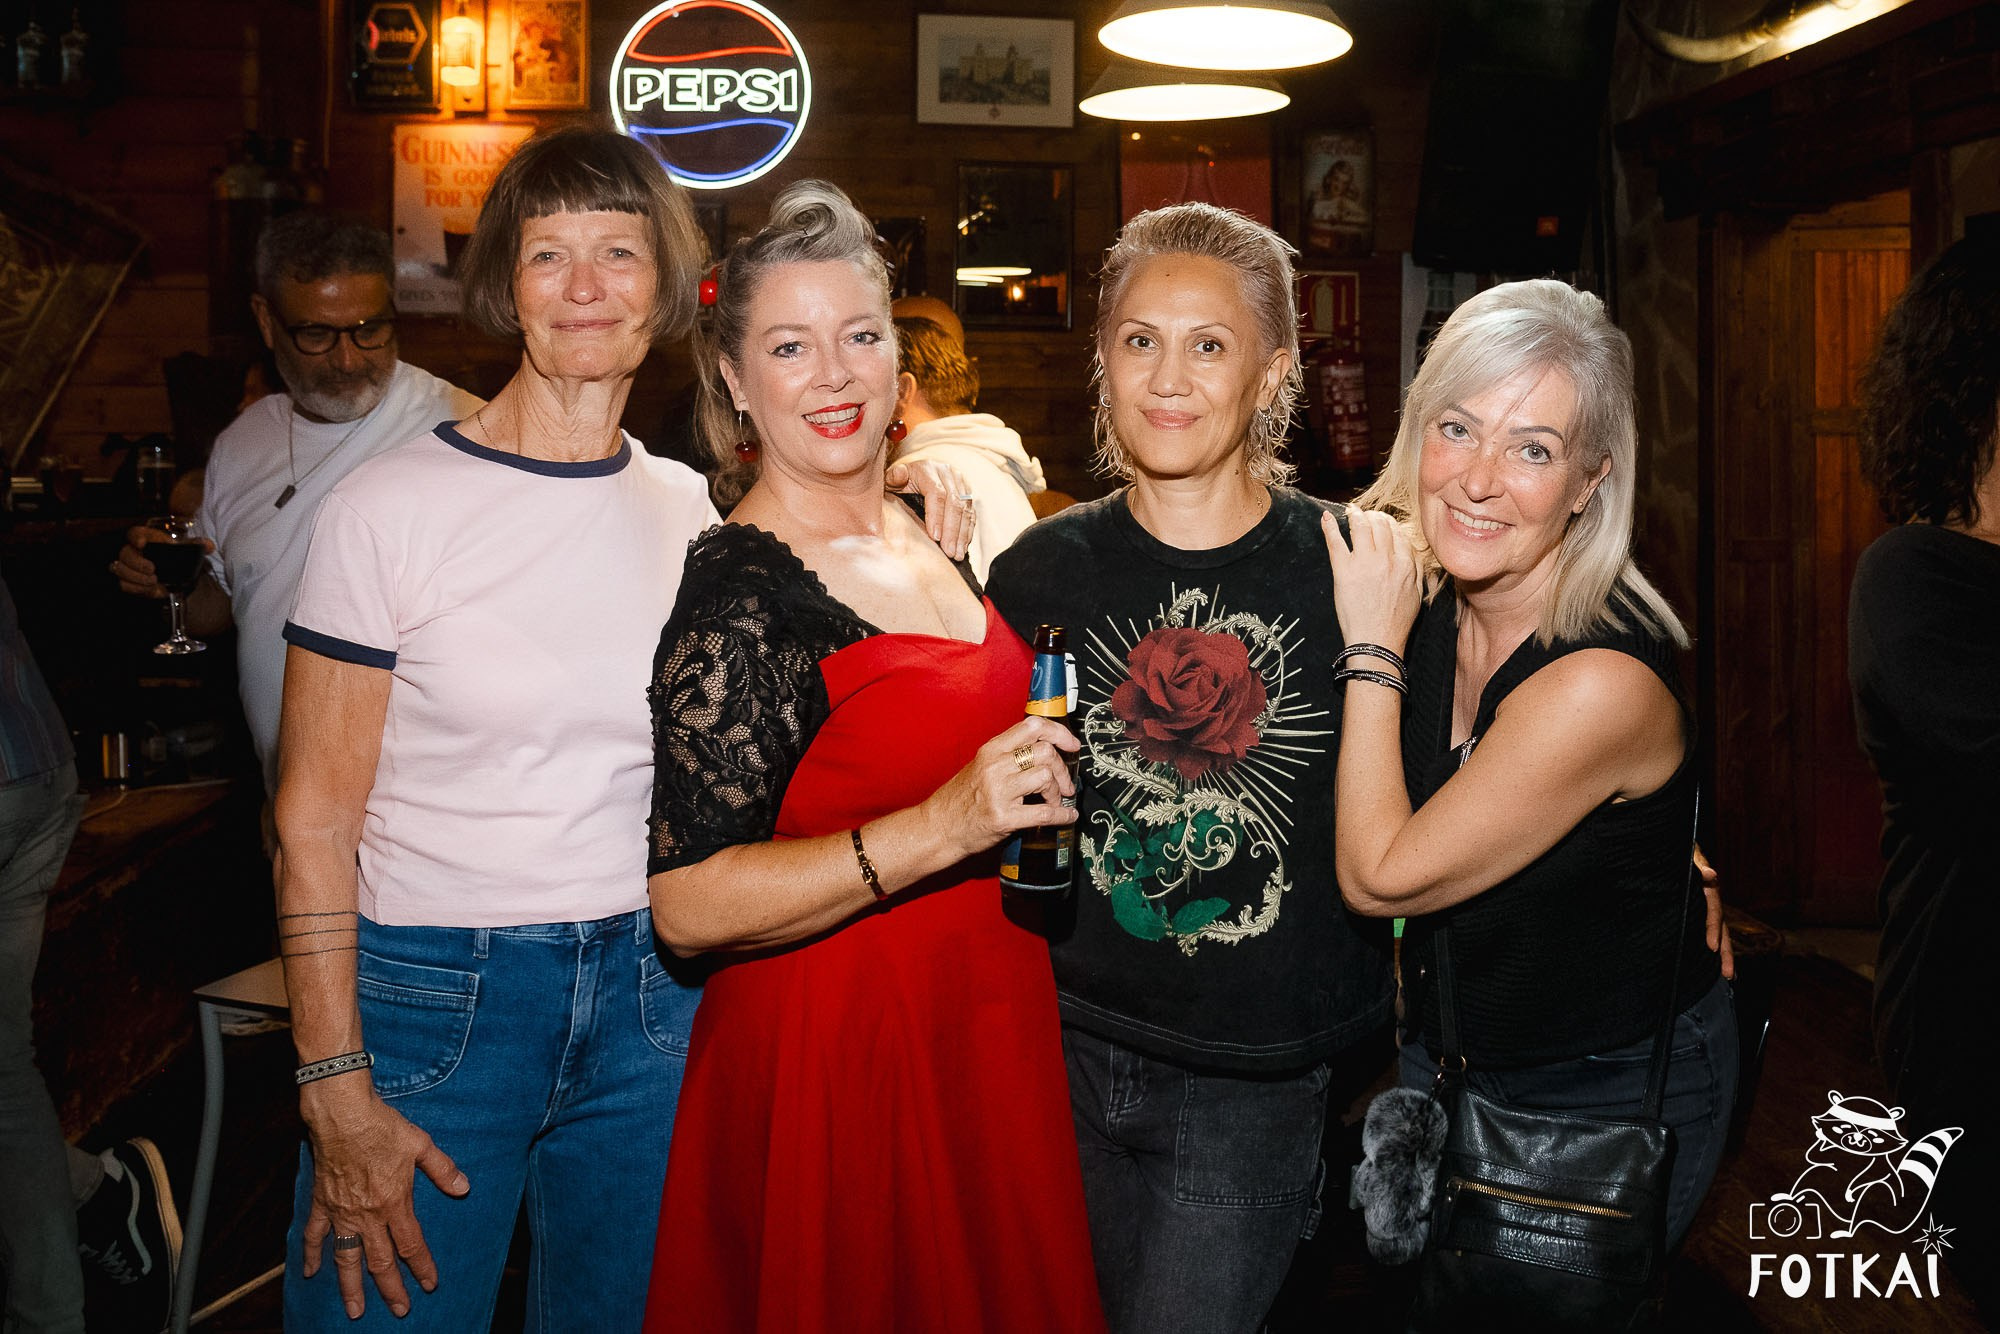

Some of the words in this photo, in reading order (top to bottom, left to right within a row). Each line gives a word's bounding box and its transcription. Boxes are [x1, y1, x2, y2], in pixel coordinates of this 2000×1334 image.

[623, 67, 798, 114] PEPSI
[424, 166, 443, 186] IS
[454, 167, 495, 186] GOO
[424, 189, 462, 208] FOR
